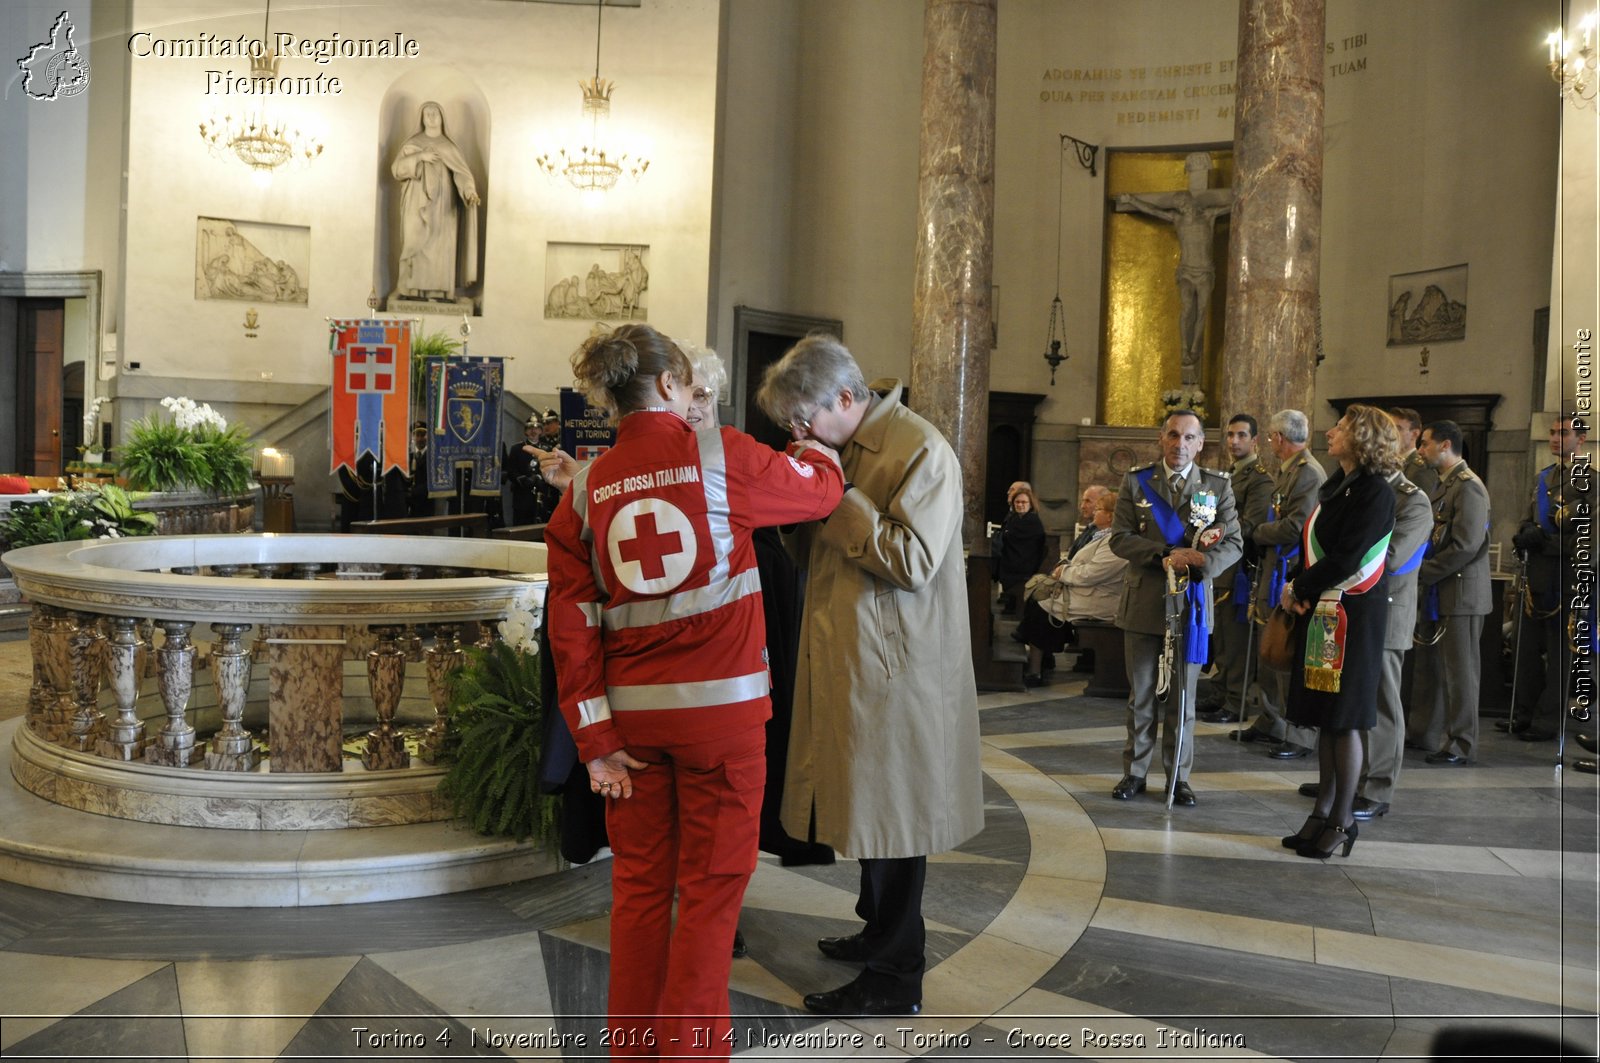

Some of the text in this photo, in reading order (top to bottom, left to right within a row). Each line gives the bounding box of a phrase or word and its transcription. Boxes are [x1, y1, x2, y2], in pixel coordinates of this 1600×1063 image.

[1042, 68, 1122, 81] ADORAMUS
[1219, 60, 1236, 73] ET
[1342, 33, 1367, 51] TIBI
[1040, 57, 1367, 103] QUIA PER SANCTAM CRUCEM TUAM
[1116, 109, 1200, 124] REDEMISTI
[576, 430, 611, 439] DI TORINO
[593, 465, 700, 504] CROCE ROSSA ITALIANA
